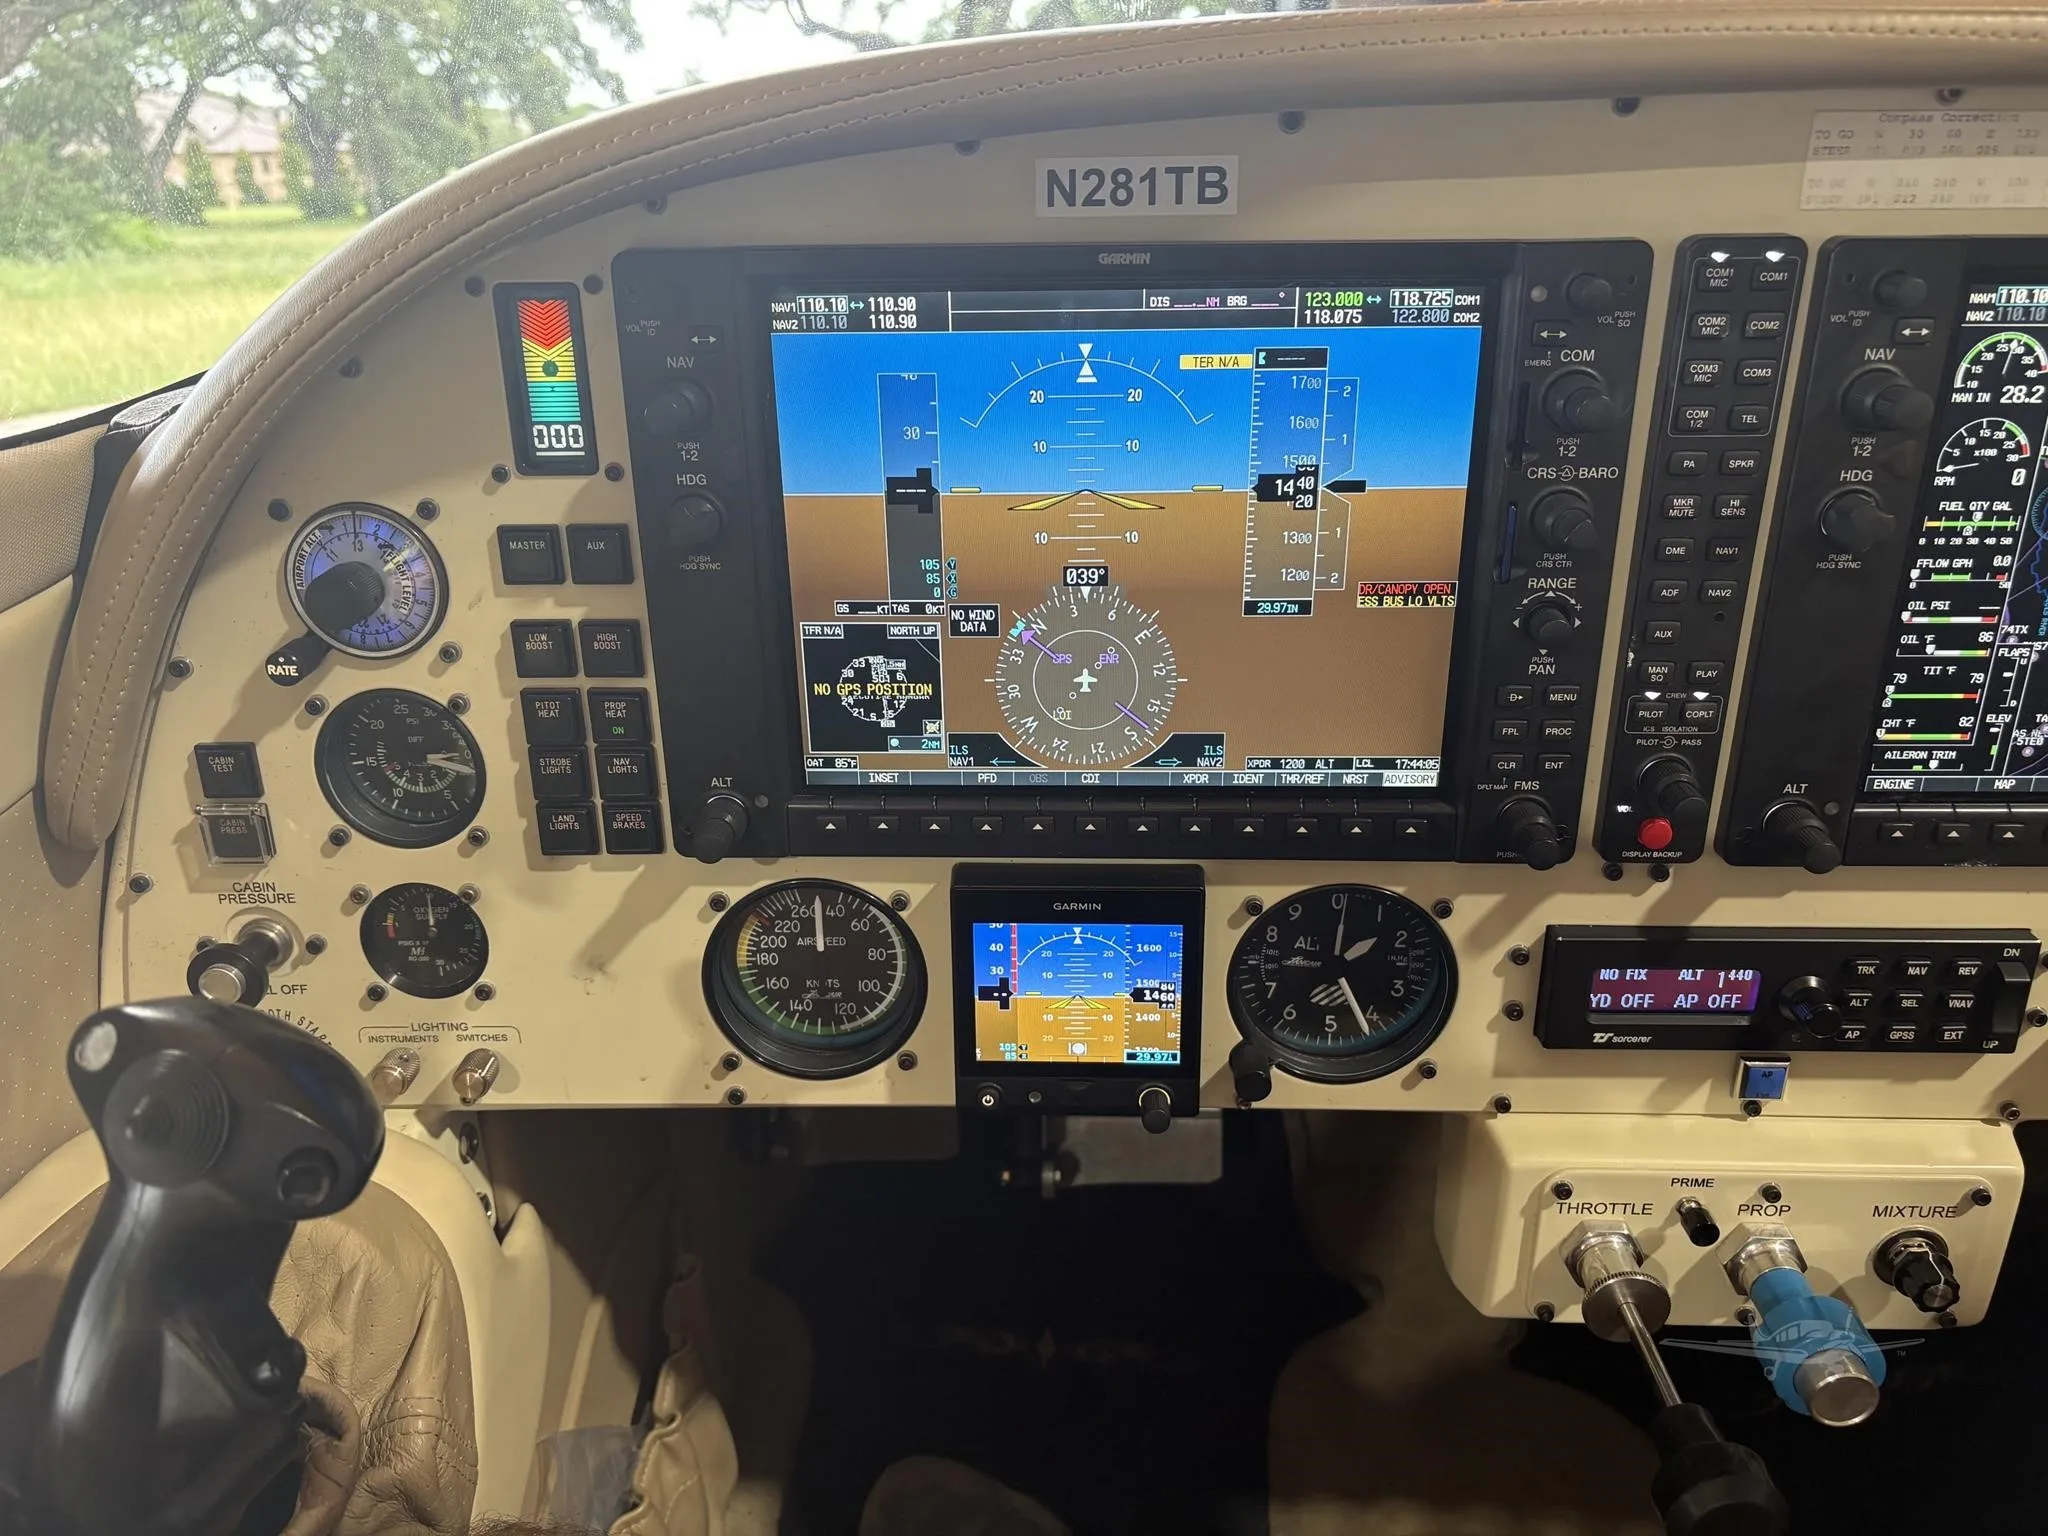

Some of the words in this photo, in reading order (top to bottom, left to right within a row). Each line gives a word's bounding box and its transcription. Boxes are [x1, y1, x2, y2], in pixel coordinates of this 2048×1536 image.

[1047, 166, 1228, 207] N281TB
[1098, 253, 1150, 265] GARMIN
[1706, 268, 1734, 277] COM1
[1760, 272, 1788, 281] COM1
[1150, 296, 1170, 308] DIS
[1227, 296, 1248, 307] BRG
[1305, 292, 1364, 306] 123.000
[1392, 292, 1451, 306] 118.725
[1455, 295, 1481, 306] COM1
[771, 302, 796, 313] NAV1
[799, 298, 846, 313] 110.10
[868, 297, 916, 312] 110.90
[1305, 309, 1362, 324] 118.075
[1392, 309, 1449, 323] 122.800
[1453, 312, 1480, 323] COM2
[773, 319, 798, 330] NAV2
[800, 315, 848, 329] 110.10
[869, 315, 917, 329] 110.90
[1560, 349, 1595, 362] COM
[1864, 348, 1896, 360] NAV
[667, 356, 695, 368] NAV
[1193, 357, 1216, 368] TER
[1219, 356, 1240, 368] N/A
[1690, 364, 1719, 373] COM3
[1743, 368, 1772, 377] COM3
[1291, 376, 1322, 389] 1700
[2000, 385, 2045, 404] 28.2
[1289, 416, 1319, 429] 1600
[1741, 415, 1759, 423] TEL
[533, 424, 584, 449] 000
[903, 427, 920, 440] 30
[1729, 460, 1754, 468] SPKR
[1527, 467, 1557, 479] CRS
[1579, 467, 1619, 479] BARO
[1840, 470, 1873, 482] HDG
[676, 474, 707, 486] HDG
[1720, 508, 1746, 516] SENS
[1939, 502, 1965, 511] FUEL
[1668, 509, 1695, 517] MUTE
[1282, 532, 1312, 545] 1300
[509, 541, 546, 550] MASTER
[1665, 547, 1686, 555] DME
[296, 550, 308, 588] AIRPORT
[1917, 559, 1949, 568] FFLOW
[1066, 568, 1105, 584] 039°
[1280, 569, 1310, 582] 1200
[386, 552, 409, 581] FLIGHT
[400, 586, 412, 611] LEVEL
[1527, 577, 1577, 589] RANGE
[1359, 584, 1420, 595] DR/CANOPY
[1424, 584, 1451, 595] OPEN
[1427, 595, 1455, 607] VLTS
[969, 609, 995, 620] WIND
[890, 626, 920, 635] NORTH
[960, 621, 987, 632] DATA
[597, 633, 617, 642] HIGH
[526, 641, 553, 650] BOOST
[594, 641, 621, 650] BOOST
[1998, 648, 2030, 657] FLAPS
[267, 664, 298, 676] RATE
[1528, 665, 1556, 675] PAN
[1696, 670, 1718, 678] PLAY
[814, 684, 831, 696] NO
[837, 683, 862, 696] GPS
[867, 683, 932, 696] POSITION
[535, 701, 560, 710] PITOT
[604, 702, 626, 710] PROP
[1685, 710, 1714, 718] COPLT
[1986, 714, 2012, 723] ELEV
[950, 745, 969, 755] ILS
[1204, 745, 1223, 755] ILS
[1884, 751, 1927, 759] AILERON
[208, 757, 234, 765] CABIN
[539, 758, 571, 767] STROBE
[950, 757, 974, 766] NAV1
[1197, 757, 1223, 767] NAV2
[1248, 759, 1271, 769] XPDR
[1280, 759, 1305, 769] 1200
[1315, 759, 1335, 769] ALT
[1395, 759, 1439, 769] 17:44:05
[212, 764, 233, 772] TEST
[541, 766, 571, 774] LIGHTS
[607, 765, 638, 774] LIGHTS
[711, 777, 733, 787] ALT
[868, 773, 899, 783] INSET
[978, 773, 997, 784] PFD
[1081, 773, 1100, 784] CDI
[1183, 774, 1209, 784] XPDR
[1233, 773, 1265, 784] IDENT
[1280, 774, 1325, 785] TMR/REF
[1343, 774, 1369, 784] NRST
[1384, 774, 1436, 785] ADVISORY
[1514, 781, 1540, 791] FMS
[1783, 783, 1808, 794] ALT
[1873, 779, 1914, 790] ENGINE
[1994, 780, 2015, 790] MAP
[615, 813, 642, 822] SPEED
[550, 822, 580, 831] LIGHTS
[612, 821, 646, 829] BRAKES
[232, 882, 276, 893] CABIN
[218, 893, 296, 905] PRESSURE
[826, 905, 845, 918] 40
[1053, 902, 1102, 911] GARMIN
[1288, 904, 1302, 920] 9
[775, 920, 800, 933] 220
[851, 919, 870, 932] 60
[1266, 926, 1278, 942] 8
[1394, 931, 1408, 948] 2
[760, 935, 787, 949] 200
[797, 937, 846, 947] AIRSEED
[1136, 944, 1162, 953] 1600
[2003, 948, 2021, 957] DN
[756, 953, 779, 965] 180
[867, 948, 887, 961] 80
[1626, 969, 1648, 981] FIX
[1678, 969, 1704, 981] ALT
[1857, 966, 1876, 975] TRK
[1907, 966, 1928, 975] NAV
[1958, 967, 1978, 975] REV
[766, 977, 790, 990] 160
[858, 980, 881, 992] 100
[1391, 980, 1404, 997] 3
[280, 984, 308, 995] OFF
[1265, 982, 1277, 999] 7
[790, 999, 813, 1012] 140
[1590, 994, 1611, 1008] YD
[1621, 994, 1655, 1008] OFF
[1674, 994, 1699, 1008] AP
[1708, 994, 1742, 1008] OFF
[1948, 1000, 1974, 1008] VNAV
[835, 1003, 857, 1015] 120
[1283, 1003, 1297, 1021] 6
[1135, 1013, 1161, 1022] 1400
[411, 1022, 469, 1032] LIGHTING
[1325, 1015, 1337, 1033] 5
[368, 1034, 439, 1043] INSTRUMENTS
[456, 1033, 508, 1042] SWITCHES
[1612, 1035, 1652, 1043] sorcerer
[1889, 1031, 1915, 1040] GPSS
[1944, 1031, 1964, 1040] EXT
[1671, 1177, 1715, 1188] PRIME
[1557, 1202, 1653, 1216] THROTTLE
[1737, 1204, 1791, 1218] PROP
[1872, 1205, 1957, 1219] MIXTURE
